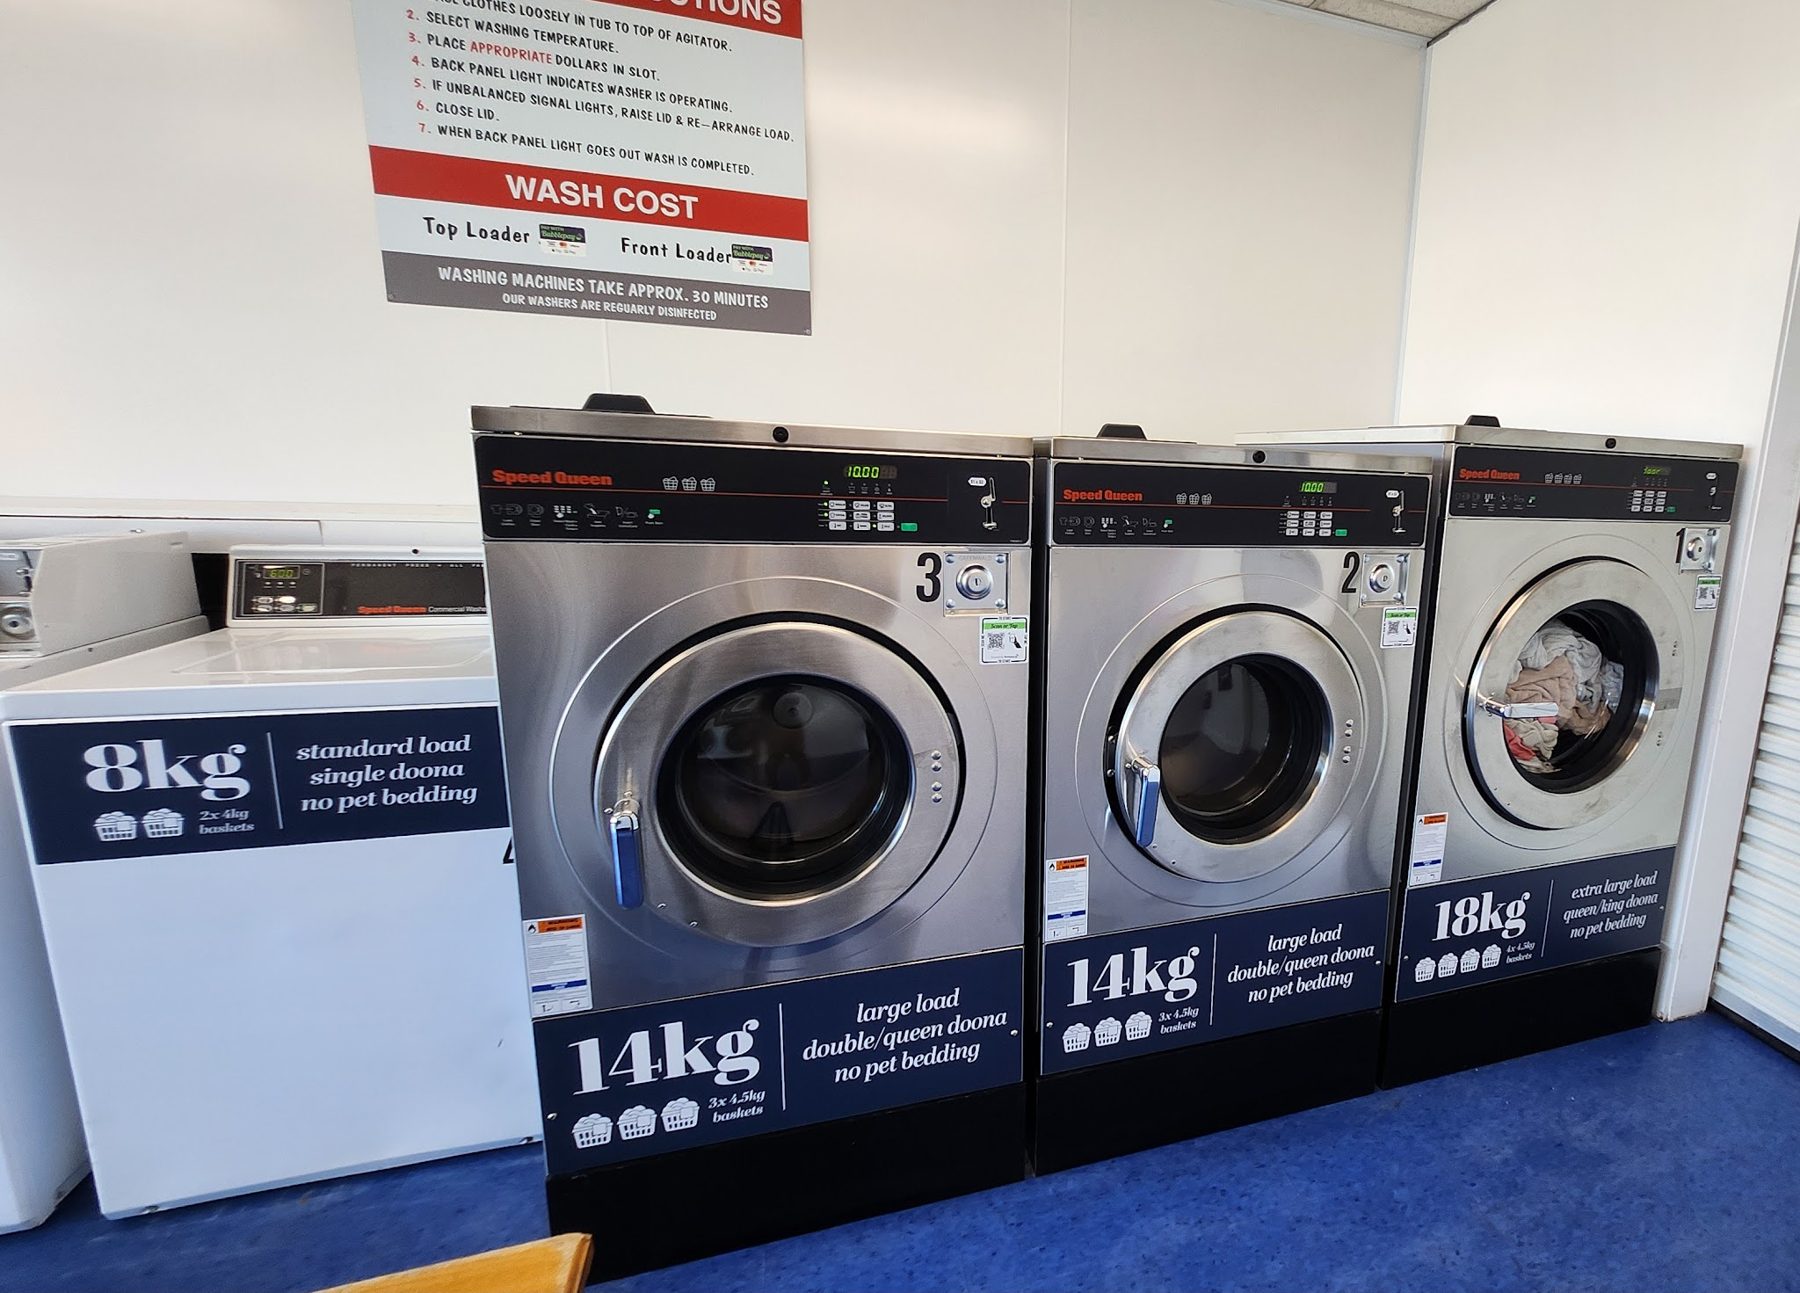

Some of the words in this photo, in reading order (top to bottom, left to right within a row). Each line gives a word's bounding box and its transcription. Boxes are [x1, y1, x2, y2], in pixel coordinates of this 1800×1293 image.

[406, 9, 419, 21] 2.
[427, 11, 470, 29] SELECT
[474, 20, 529, 39] WASHING
[533, 29, 619, 53] TEMPERATURE.
[519, 4, 570, 24] LOOSELY
[574, 14, 585, 26] IN
[589, 16, 611, 30] TUB
[615, 21, 629, 34] TO
[633, 24, 653, 37] TOP
[658, 29, 672, 40] OF
[676, 31, 732, 51] AGITATOR.
[408, 32, 421, 44] 3.
[427, 33, 466, 51] PLACE
[470, 41, 552, 64] APPROPRIATE
[556, 56, 608, 73] DOLLARS
[613, 63, 624, 75] IN
[628, 67, 660, 81] SLOT.
[411, 55, 425, 67] 4.
[431, 57, 466, 73] BACK
[469, 62, 506, 79] PANEL
[510, 69, 543, 84] LIGHT
[546, 75, 604, 93] INDICATES
[607, 84, 652, 100] WASHER
[655, 91, 666, 102] IS
[669, 93, 733, 113] OPERATING.
[414, 78, 426, 89] 5.
[432, 79, 443, 91] IF
[446, 82, 526, 103] UNBALANCED
[530, 94, 572, 110] SIGNAL
[575, 99, 618, 118] LIGHTS,
[621, 107, 653, 121] RAISE
[656, 111, 672, 124] LID
[675, 115, 684, 126] &
[764, 128, 794, 142] LOAD.
[416, 100, 429, 111] 6.
[436, 102, 473, 118] CLOSE
[477, 108, 500, 121] LID.
[418, 123, 431, 134] 7.
[438, 124, 471, 139] WHEN
[475, 129, 507, 144] BACK
[511, 134, 547, 149] PANEL
[551, 139, 581, 153] LIGHT
[586, 143, 616, 158] GOES
[619, 148, 640, 160] OUT
[644, 152, 675, 166] WASH
[678, 156, 687, 167] IS
[691, 158, 755, 176] COMPLETED.
[505, 173, 604, 209] WASH
[613, 187, 699, 219] COST
[423, 216, 458, 240] Top
[466, 221, 530, 243] Loader
[621, 237, 668, 258] Front
[676, 243, 732, 264] Loader
[438, 266, 508, 285] WASHING
[512, 272, 584, 292] MACHINES
[588, 279, 624, 296] TAKE
[628, 282, 689, 302] APPROX.
[692, 290, 711, 303] 30
[714, 291, 769, 308] MINUTES
[502, 293, 525, 305] OUR
[527, 295, 578, 309] WASHERS
[580, 300, 602, 311] ARE
[603, 302, 655, 316] REGUARLY
[658, 306, 717, 320] DISINFECTED
[492, 469, 553, 485] Speed
[554, 471, 613, 486] Queen
[1459, 468, 1489, 480] Speed
[1490, 469, 1520, 480] Queen
[1063, 488, 1102, 501] Speed
[1104, 490, 1143, 502] Queen
[1675, 527, 1686, 564] 1
[916, 552, 942, 603] 3
[1341, 551, 1361, 594] 2
[296, 737, 415, 761] standard
[418, 734, 472, 754] load
[83, 739, 251, 802] 8kg
[310, 764, 386, 788] single
[389, 762, 466, 782] doona
[301, 797, 333, 812] no
[337, 790, 378, 814] pet
[381, 784, 478, 806] bedding
[199, 810, 220, 821] 2x
[222, 808, 250, 822] 4kg
[199, 821, 255, 835] baskets
[1571, 884, 1603, 899] extra
[1603, 879, 1633, 894] large
[1633, 870, 1658, 887] load
[1432, 892, 1531, 942] 18kg
[1563, 899, 1625, 924] queen/king
[1625, 893, 1658, 908] doona
[1268, 931, 1309, 954] large
[1309, 923, 1343, 943] load
[1570, 927, 1585, 938] no
[1584, 921, 1604, 939] pet
[1604, 913, 1647, 934] bedding
[1227, 954, 1328, 983] double/queen
[1331, 944, 1375, 964] doona
[1506, 953, 1532, 964] baskets
[1066, 945, 1200, 1007] 14kg
[1248, 986, 1269, 1003] no
[1269, 981, 1294, 1004] pet
[1295, 970, 1354, 994] bedding
[856, 999, 913, 1025] large
[915, 987, 960, 1013] load
[1158, 1011, 1171, 1022] 3x
[1172, 1005, 1199, 1020] 4.5kg
[802, 1023, 944, 1061] double/queen
[947, 1010, 1007, 1037] doona
[1160, 1019, 1197, 1035] baskets
[567, 1018, 760, 1096] 14kg
[834, 1064, 863, 1083] no
[865, 1055, 898, 1083] pet
[900, 1040, 981, 1071] bedding
[708, 1095, 727, 1110] 3x
[727, 1088, 766, 1107] 4.5kg
[712, 1103, 765, 1124] baskets
